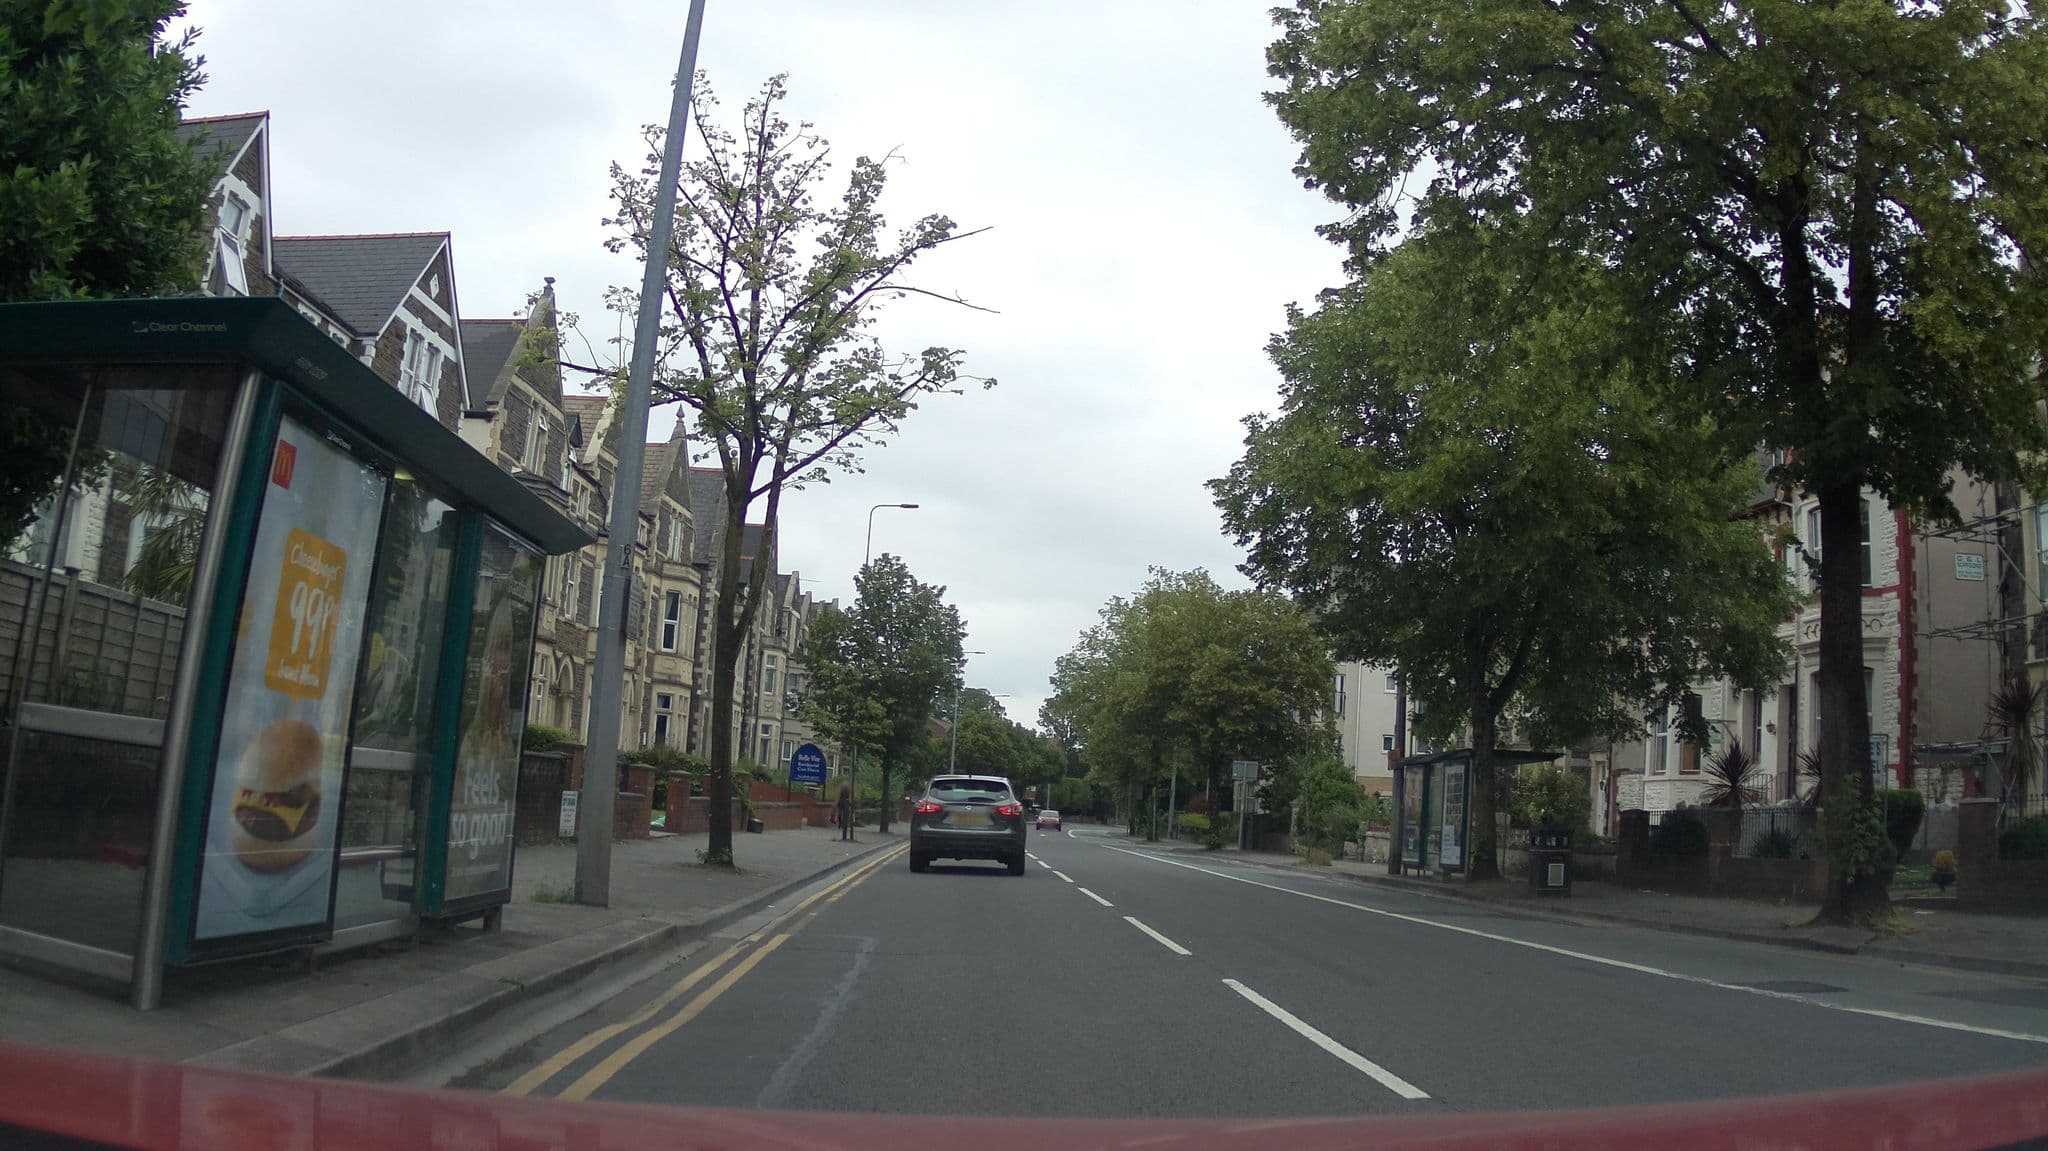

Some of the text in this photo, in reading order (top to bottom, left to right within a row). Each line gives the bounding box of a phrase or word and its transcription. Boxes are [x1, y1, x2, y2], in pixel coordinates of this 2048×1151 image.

[149, 321, 228, 333] Clear Channel
[623, 543, 632, 555] 6
[622, 555, 631, 567] A
[463, 760, 501, 805] Feels
